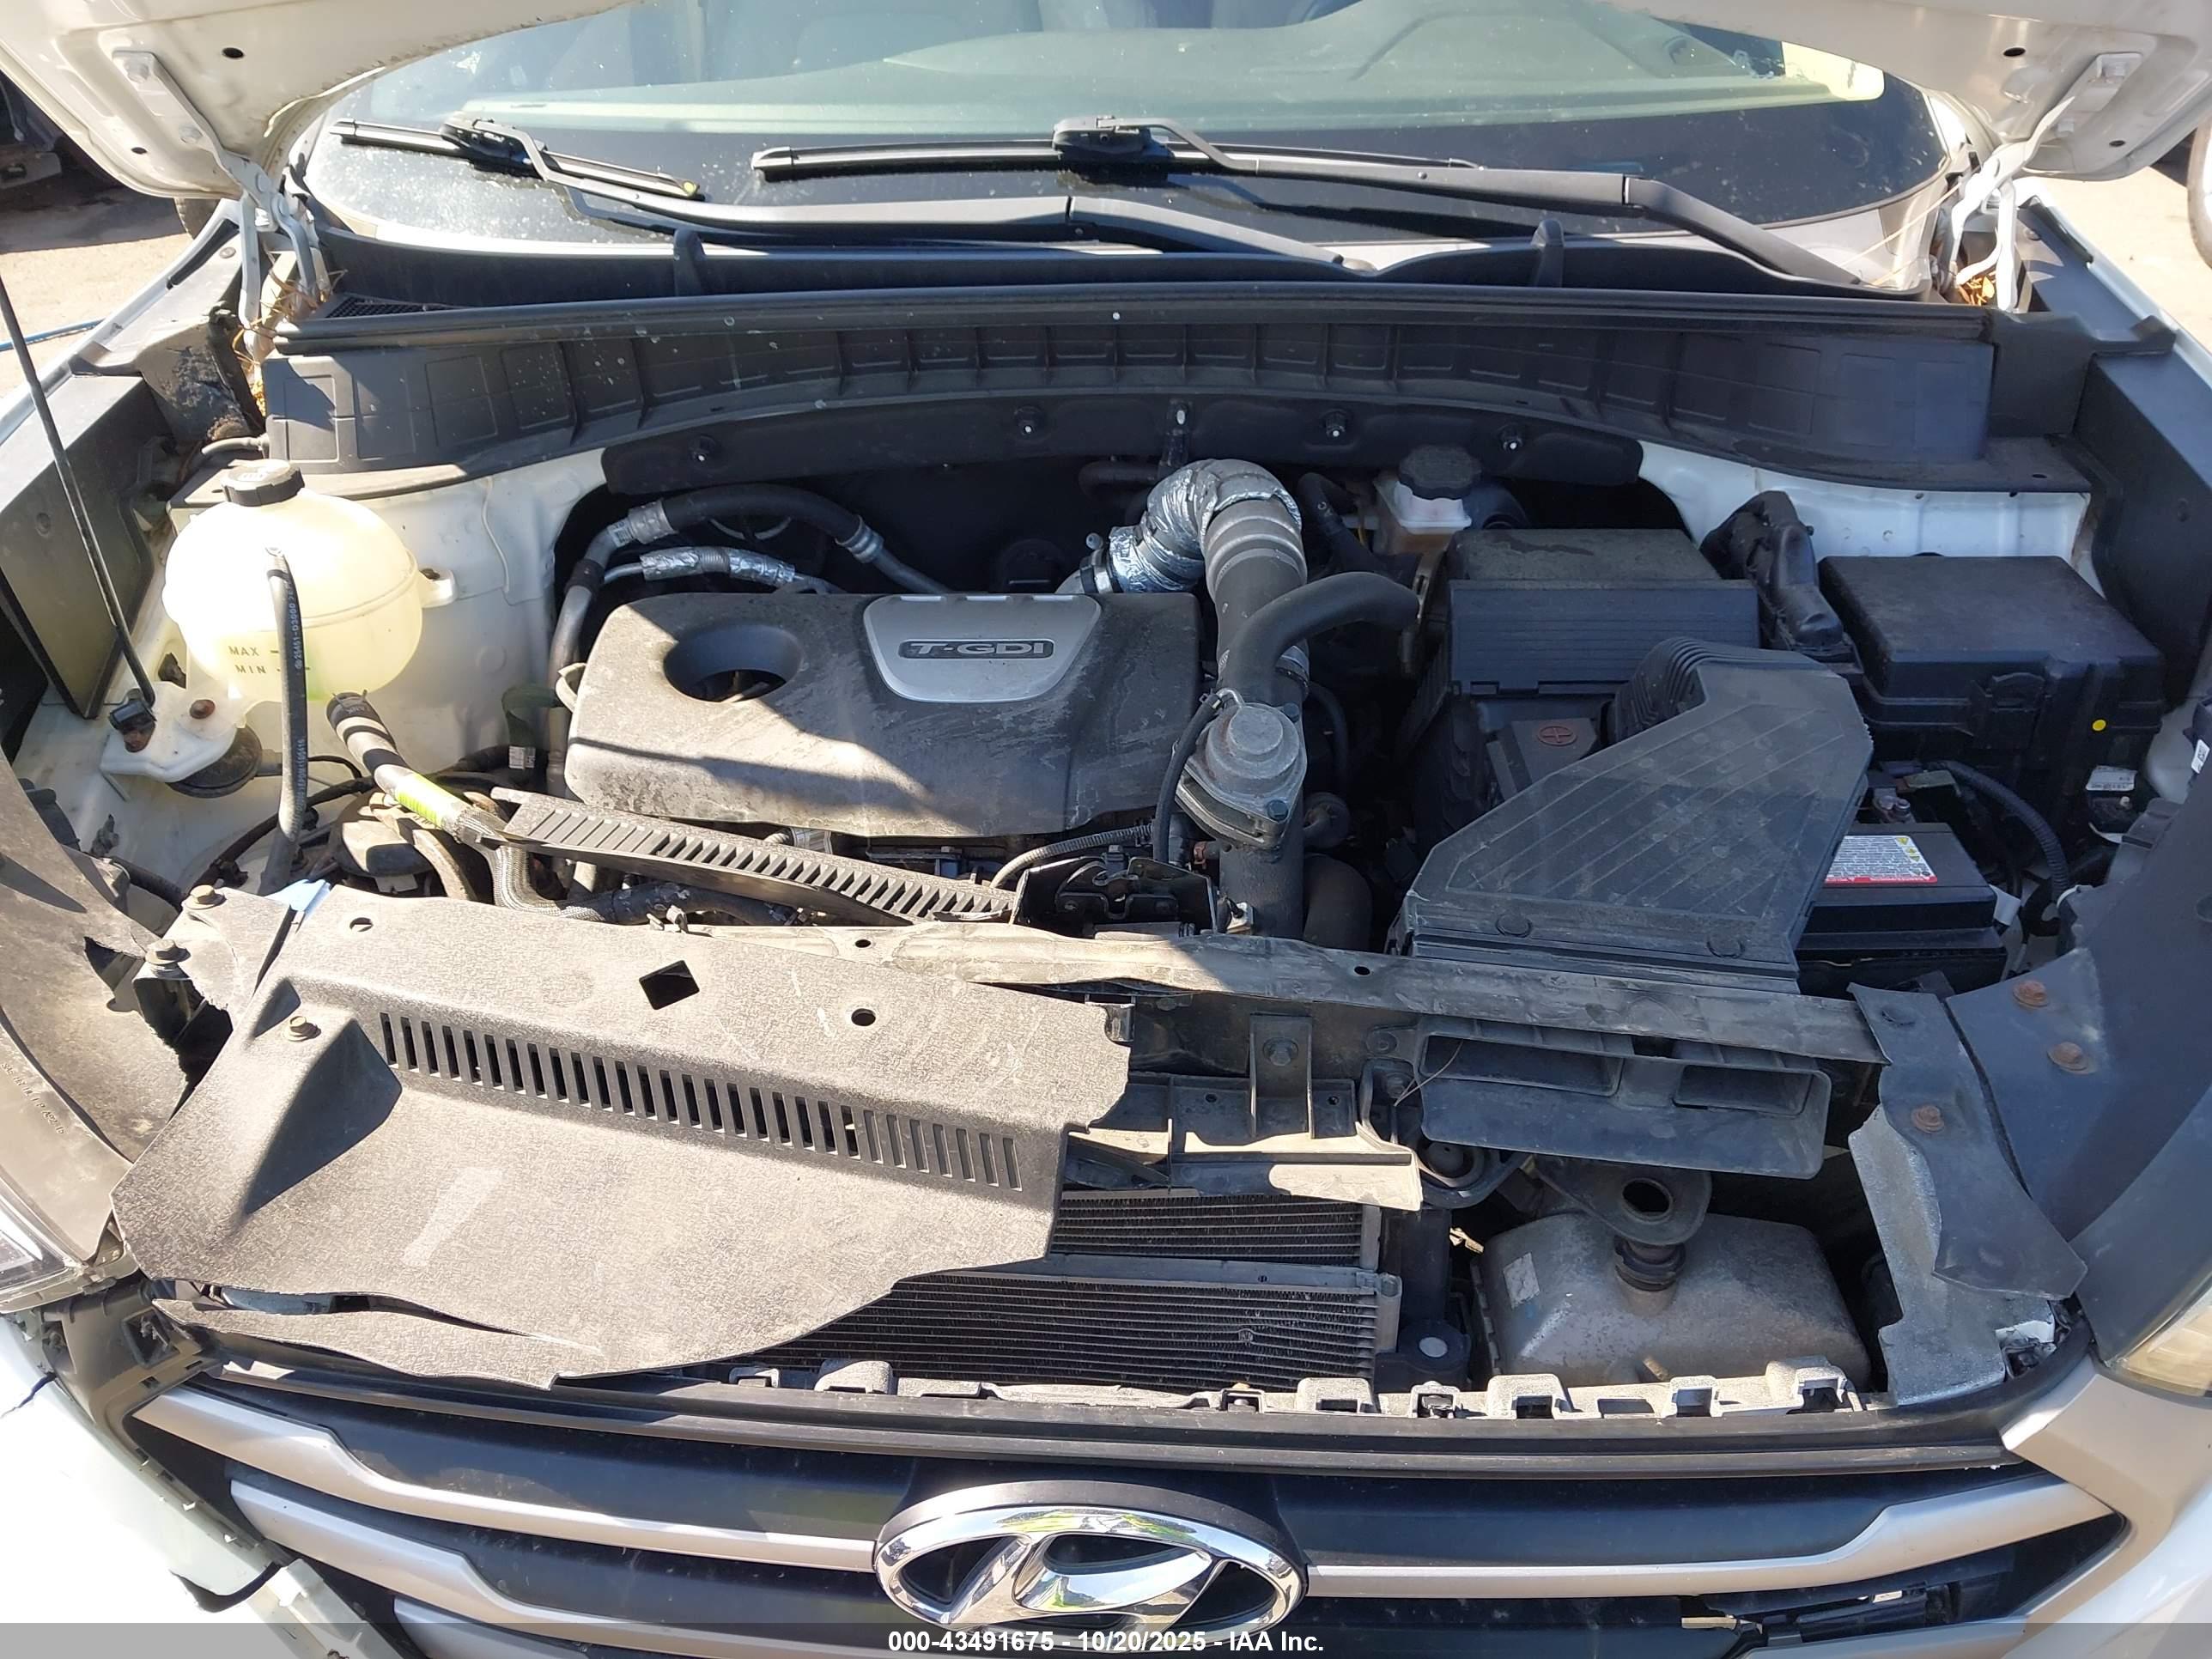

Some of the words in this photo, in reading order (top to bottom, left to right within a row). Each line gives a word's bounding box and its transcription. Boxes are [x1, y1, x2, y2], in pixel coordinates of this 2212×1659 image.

[228, 645, 259, 656] MAX
[911, 642, 1044, 654] T-GDI
[234, 665, 266, 674] MIN
